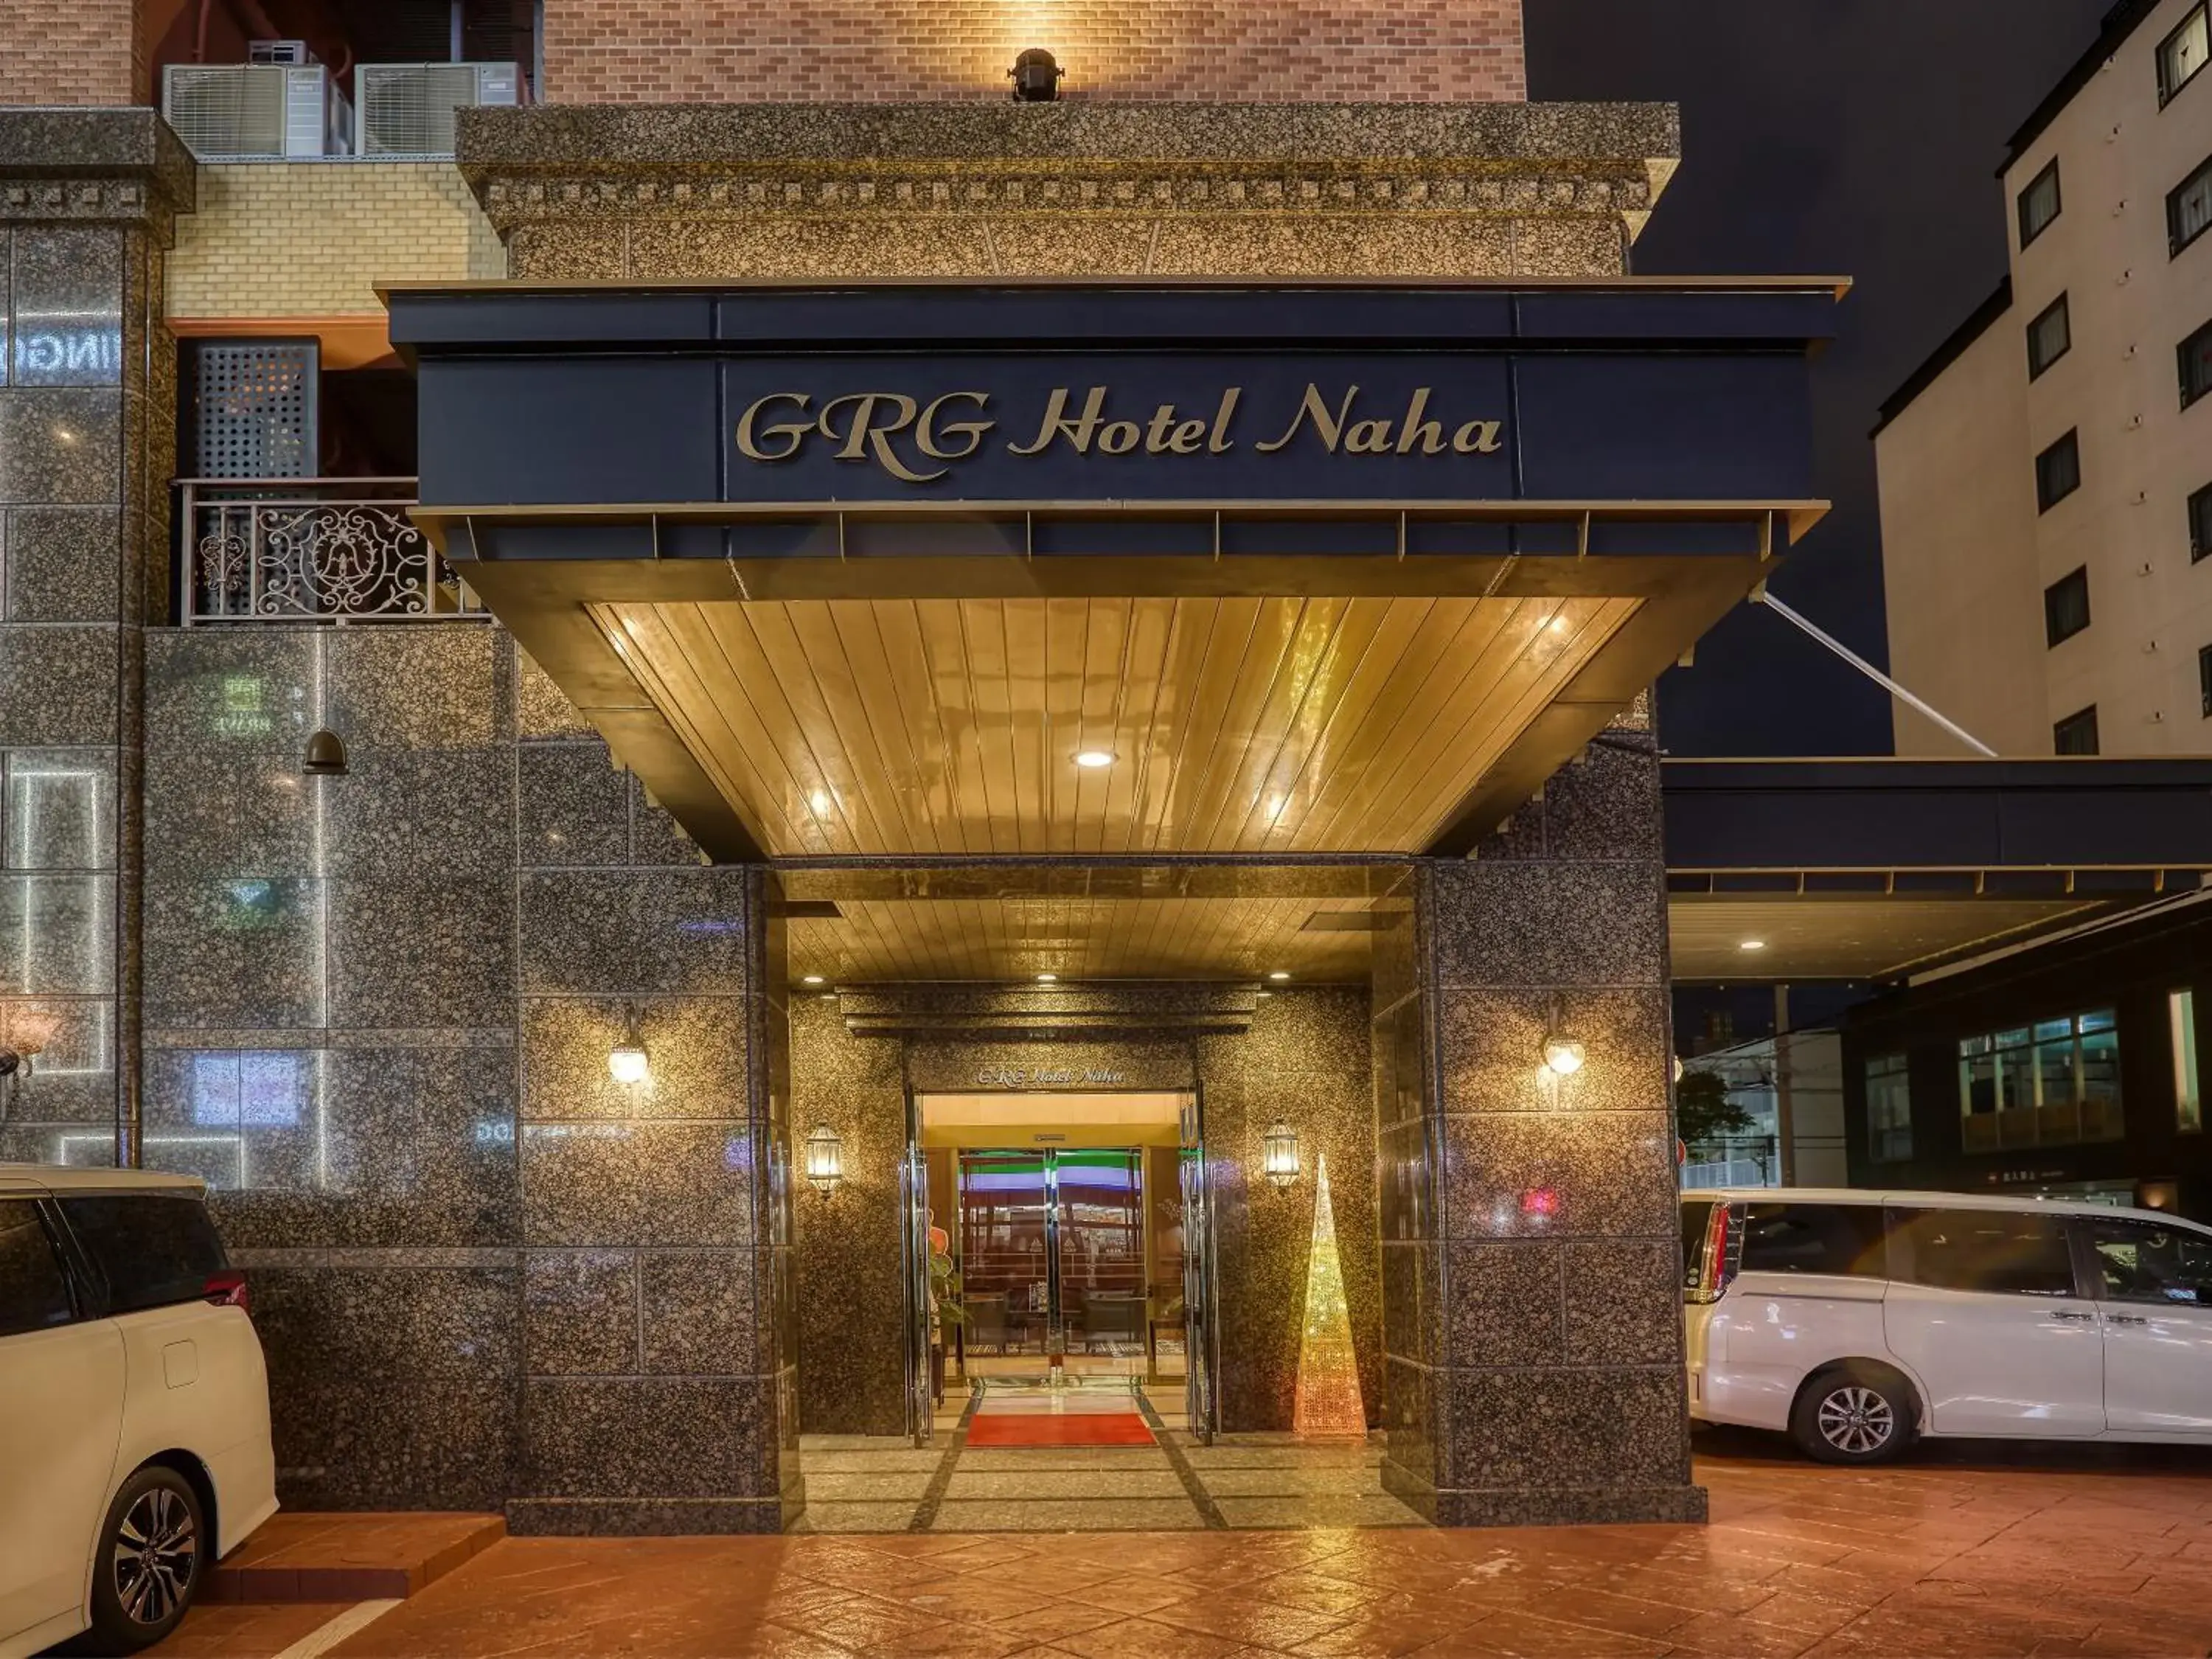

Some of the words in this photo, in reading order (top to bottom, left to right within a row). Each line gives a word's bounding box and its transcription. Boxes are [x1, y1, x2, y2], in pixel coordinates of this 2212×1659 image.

[735, 392, 996, 482] GRG
[1006, 386, 1242, 454] Hotel
[1255, 383, 1502, 454] Naha
